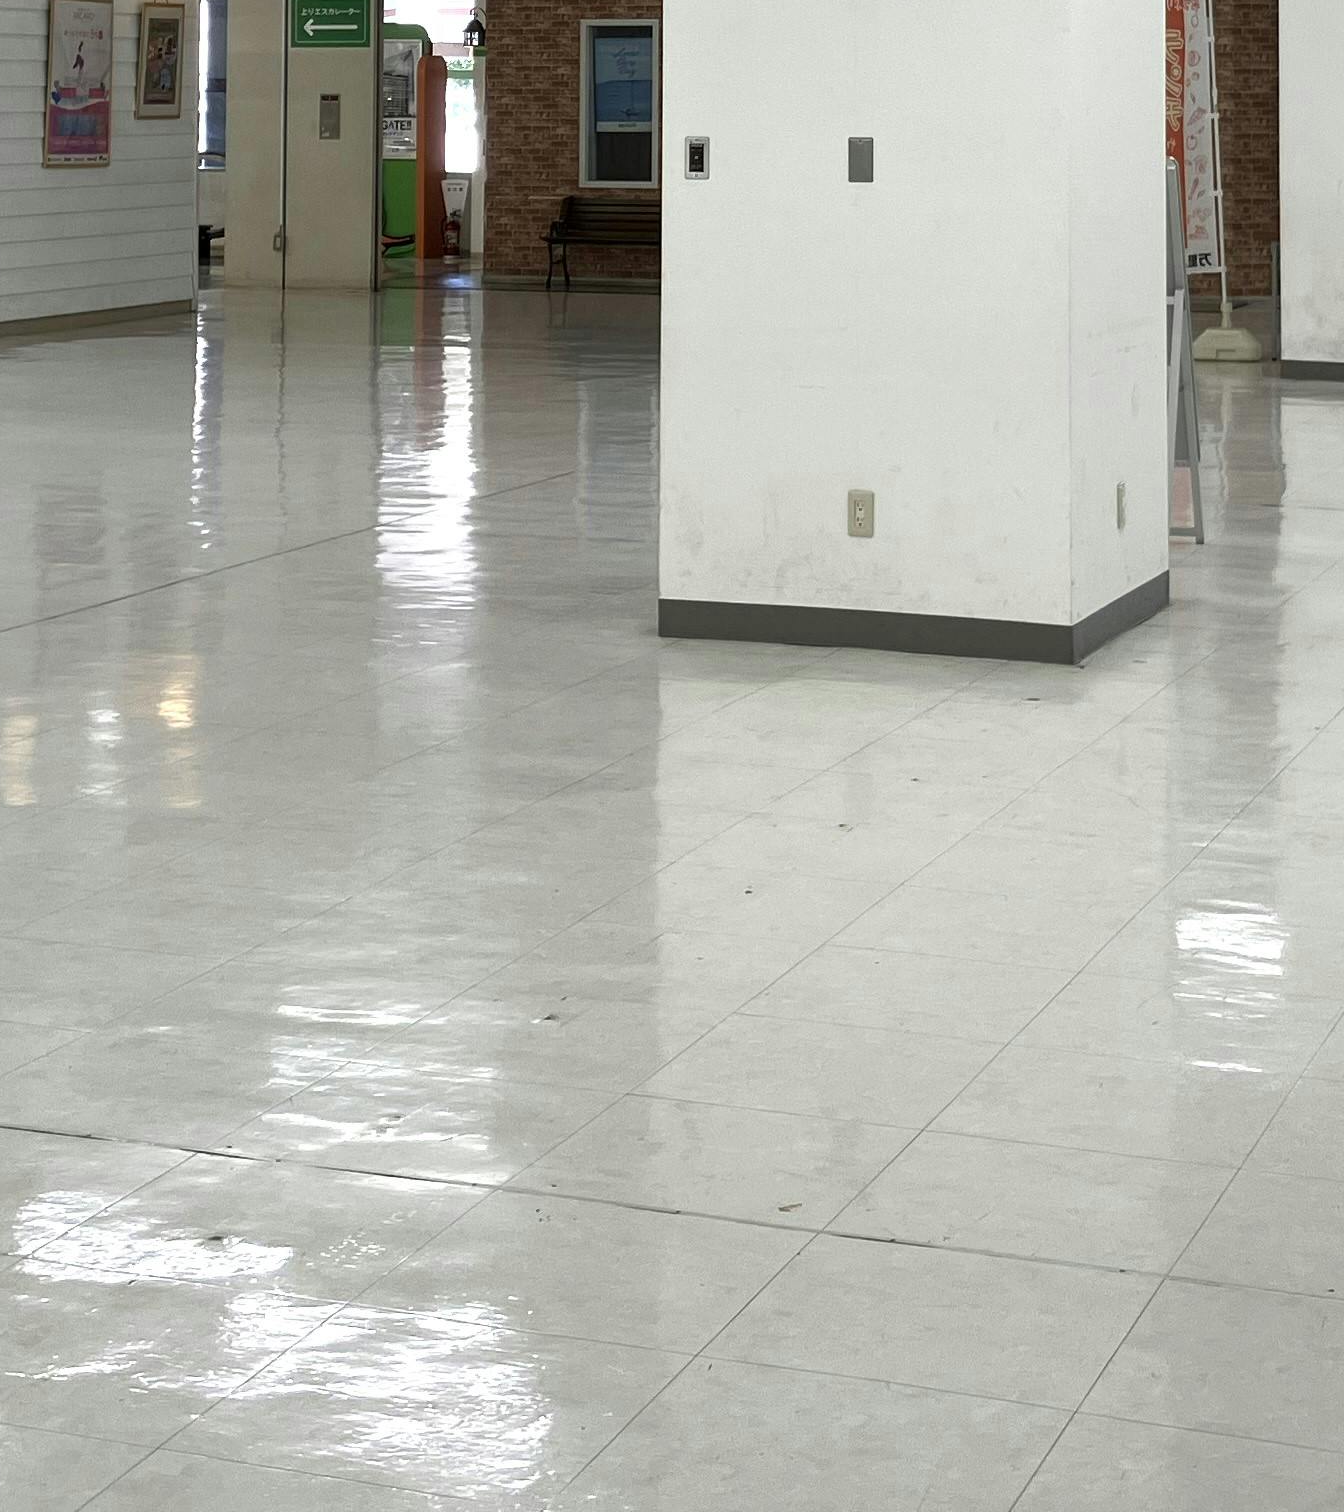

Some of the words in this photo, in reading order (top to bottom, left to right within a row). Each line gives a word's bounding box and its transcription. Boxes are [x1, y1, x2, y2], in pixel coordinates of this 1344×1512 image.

[301, 7, 361, 16] 上りエスカレーター
